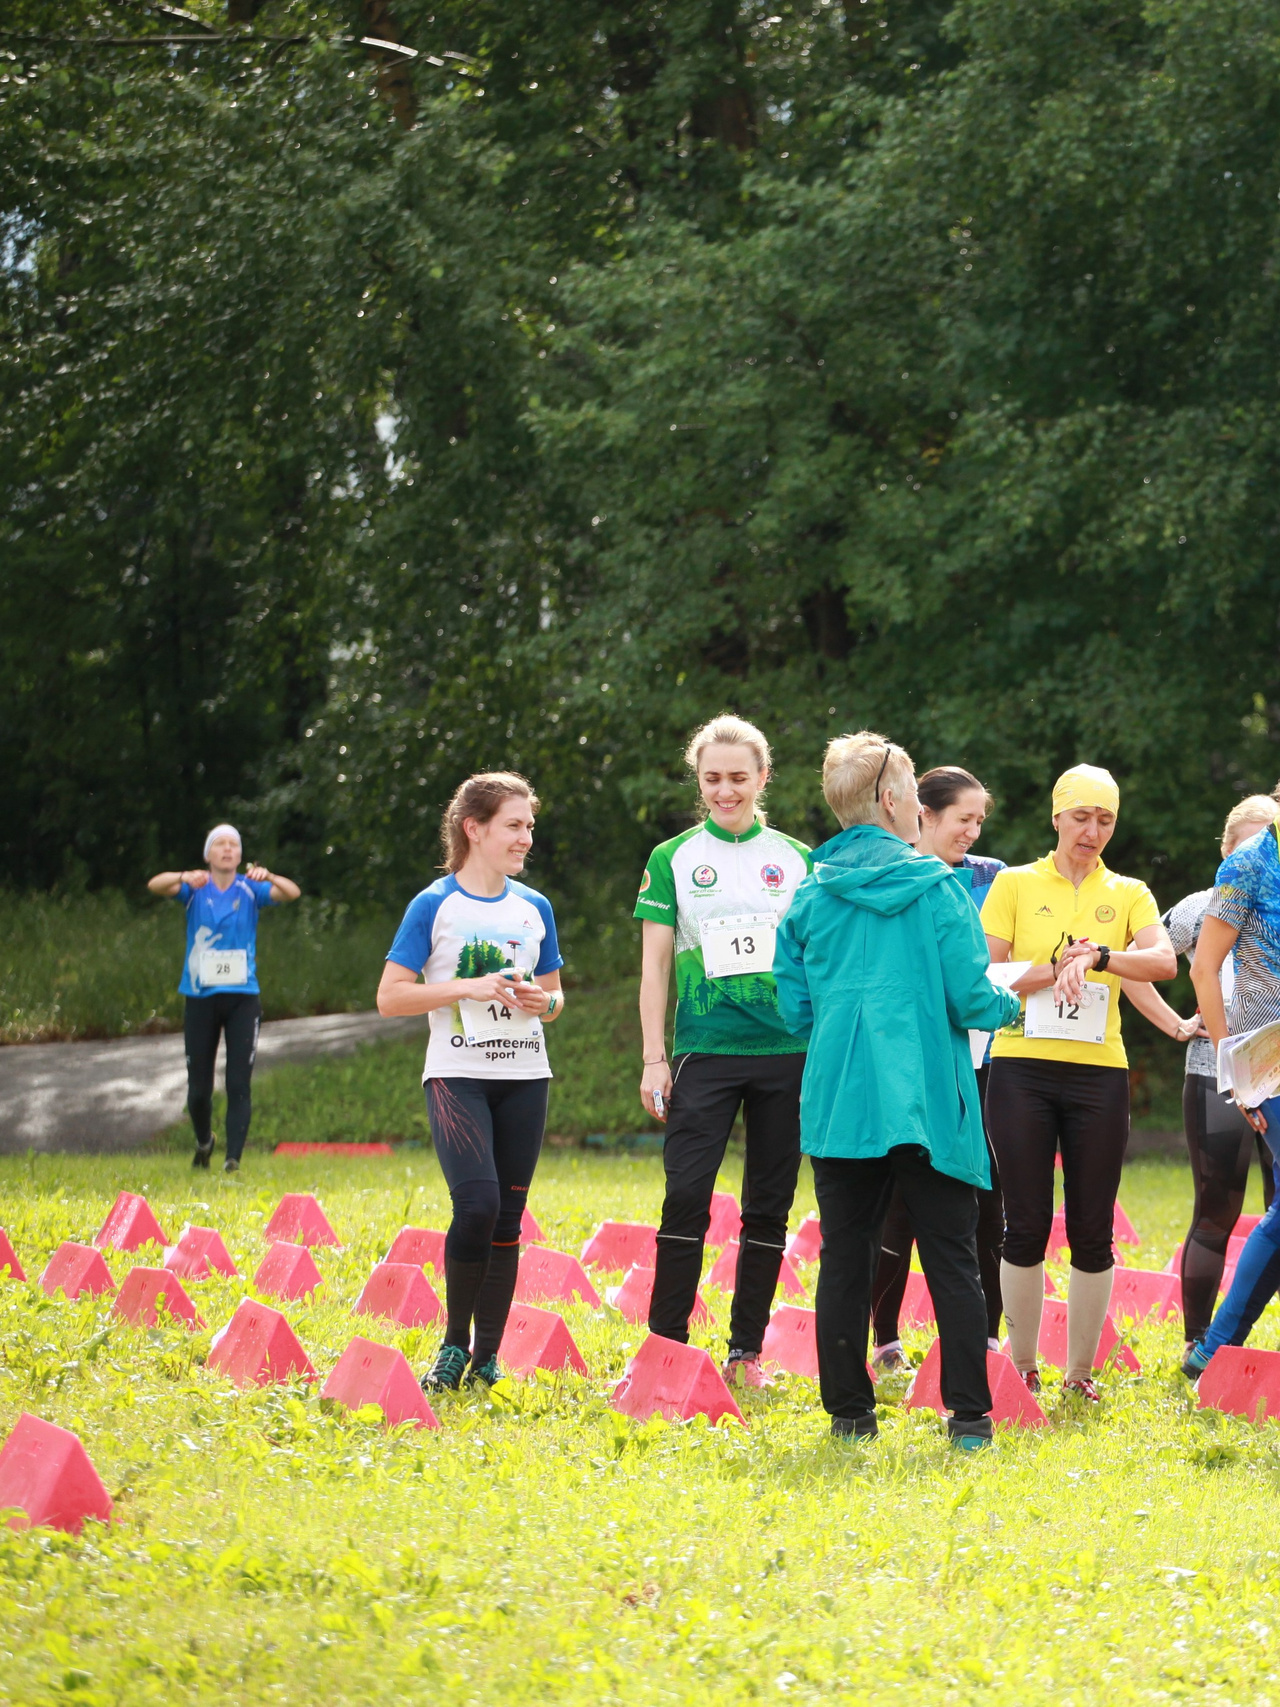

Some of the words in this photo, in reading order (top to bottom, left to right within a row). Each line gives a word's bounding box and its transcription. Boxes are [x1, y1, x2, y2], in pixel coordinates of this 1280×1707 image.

[639, 897, 671, 910] Labirint
[730, 935, 756, 956] 13
[215, 963, 231, 976] 28
[487, 1003, 512, 1022] 14
[1054, 1000, 1079, 1021] 12
[485, 1050, 516, 1061] sport
